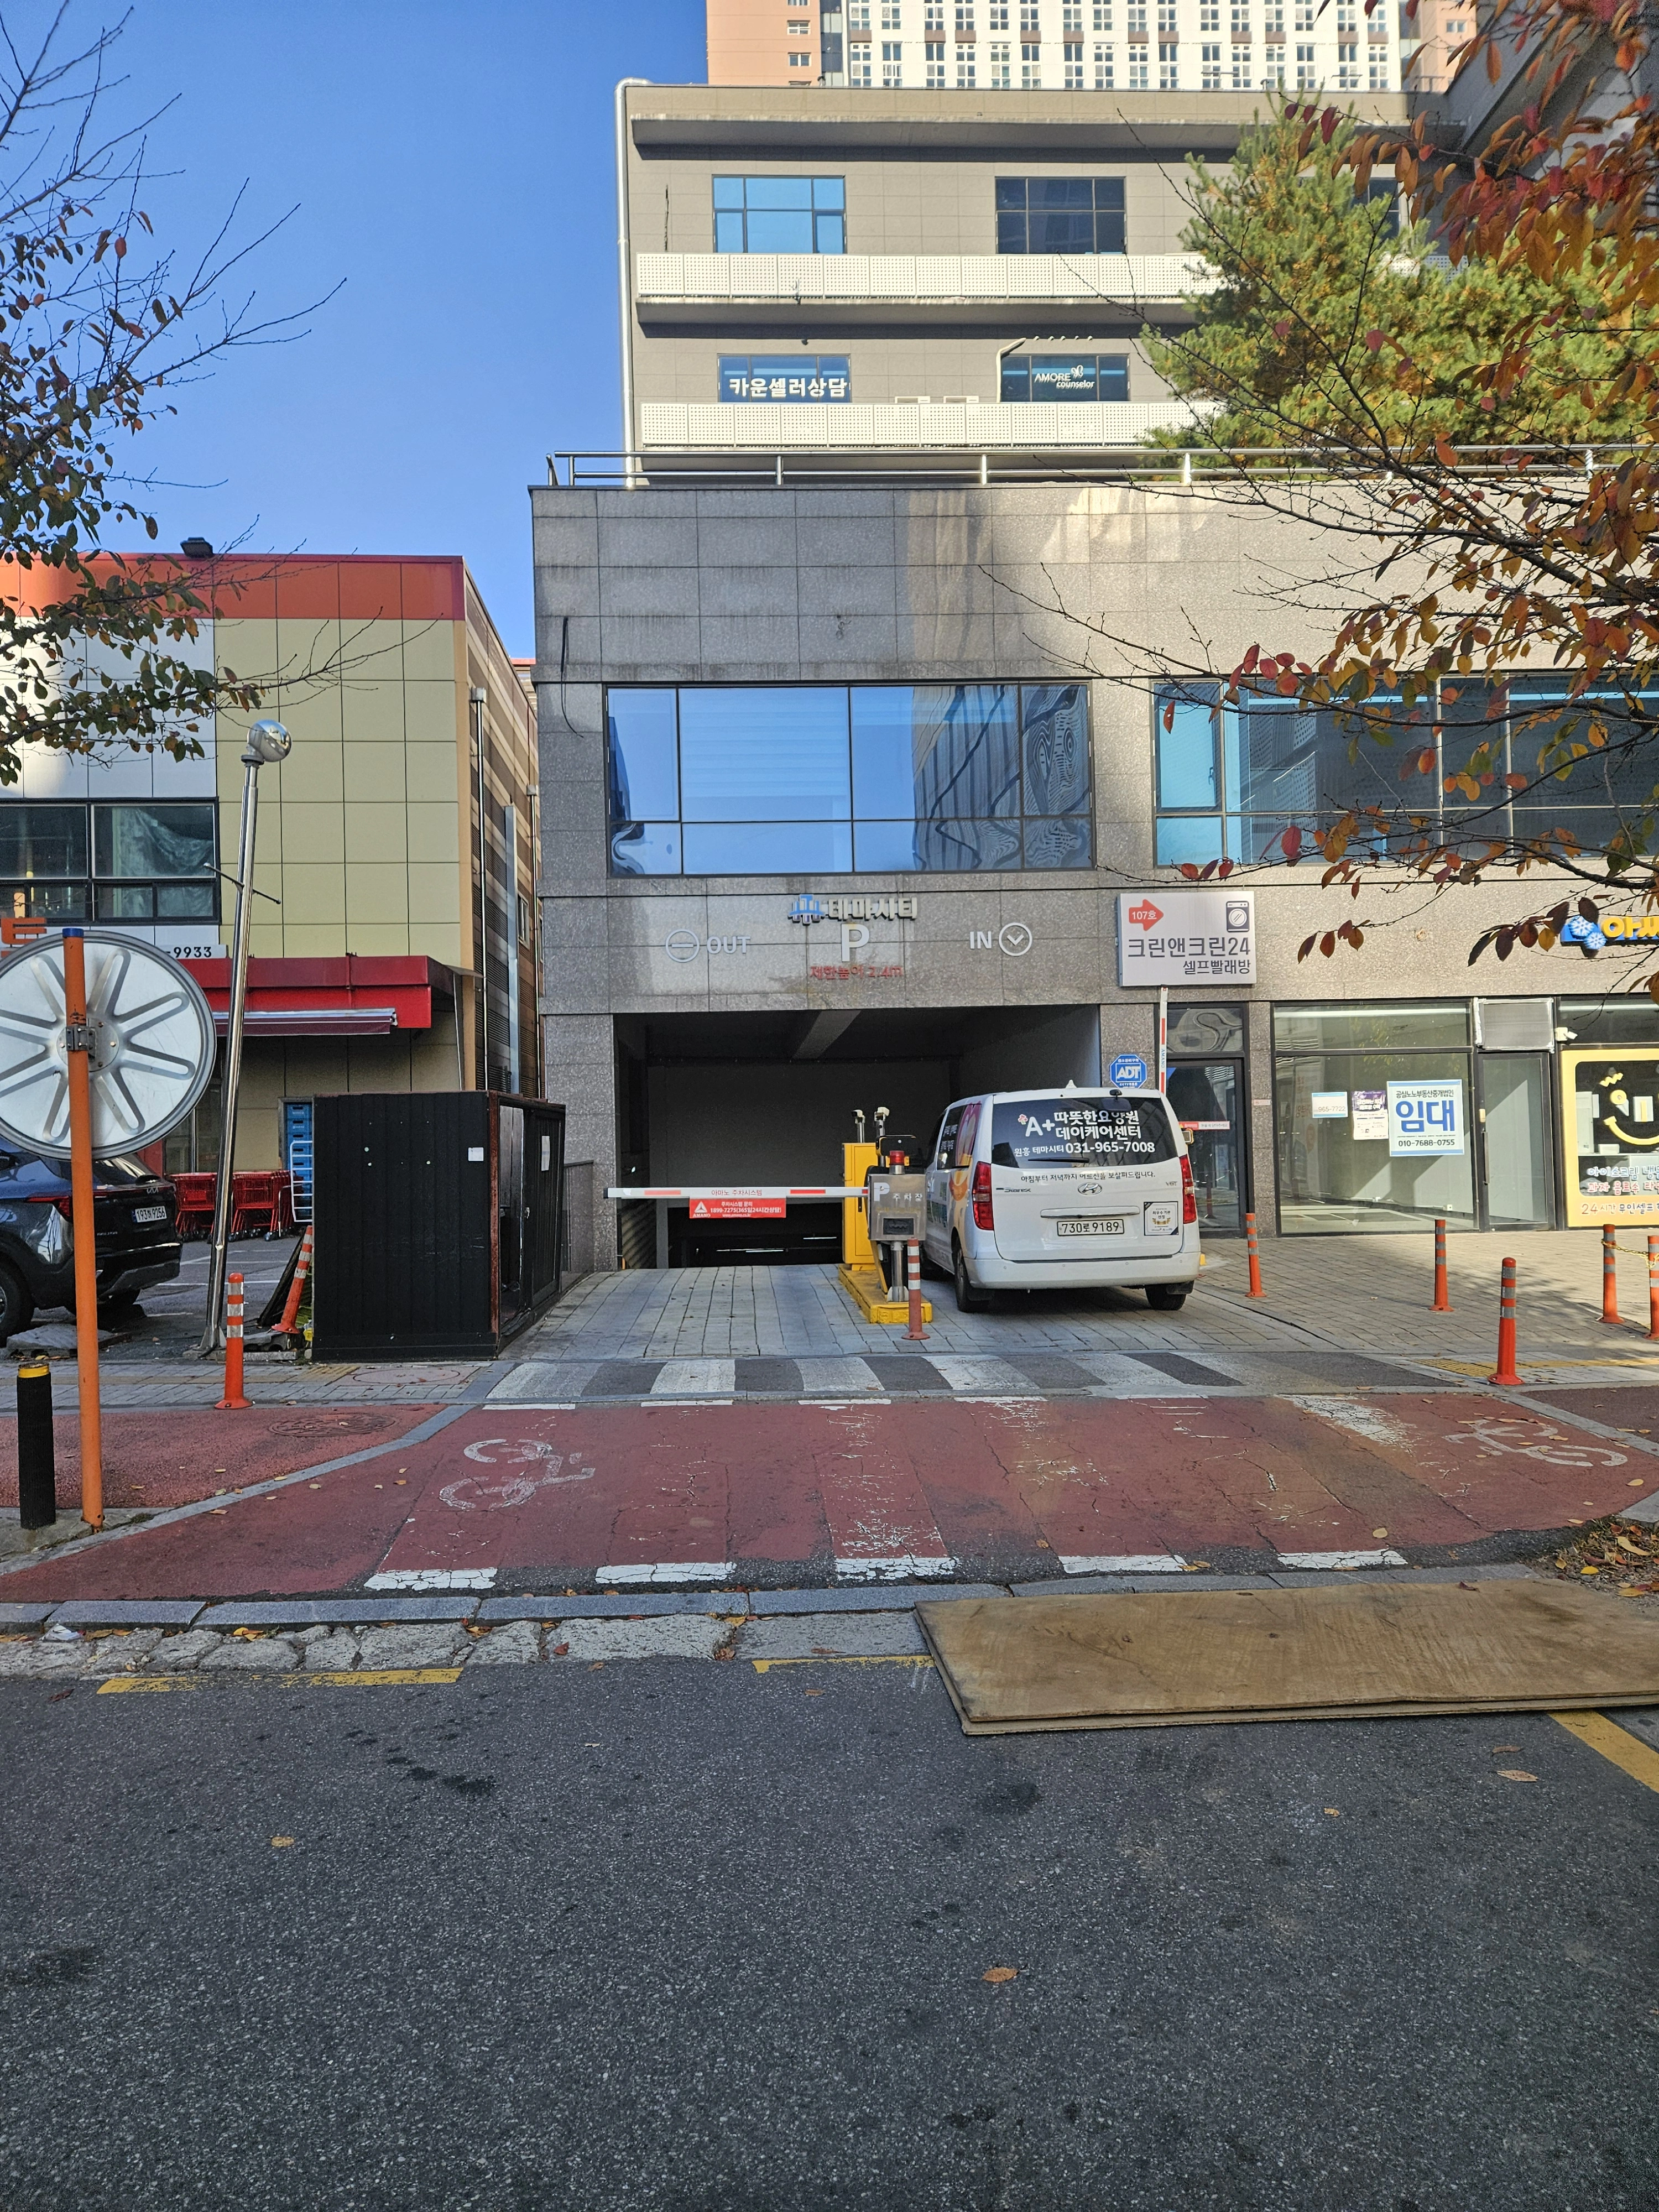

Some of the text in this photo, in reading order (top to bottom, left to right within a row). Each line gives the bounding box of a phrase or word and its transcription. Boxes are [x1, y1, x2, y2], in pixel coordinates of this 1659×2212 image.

[1034, 373, 1071, 383] AMORE
[1056, 380, 1095, 389] counselor
[729, 377, 847, 398] 카운셀러상담
[828, 897, 917, 920] 테마시티
[1132, 910, 1157, 920] 107호
[707, 936, 751, 954] OUT
[841, 924, 870, 962] P
[969, 931, 992, 950] IN
[1128, 937, 1251, 958] 크린앤크린24
[868, 965, 904, 978] 2.4m
[1183, 959, 1251, 975] 셀프빨래방
[1117, 1066, 1140, 1079] ADT
[1396, 1089, 1454, 1098] 공실노노부동산중개법인
[1395, 1100, 1455, 1133] 임대
[1025, 1116, 1055, 1137] A+
[1055, 1125, 1141, 1140] 데이케어센터
[1014, 1141, 1155, 1157] 원흥 테마시티 031-965-7008
[1021, 1174, 1048, 1183] 아침부터
[1050, 1173, 1078, 1182] 저녁까지
[1587, 1166, 1640, 1180] 아이스크림
[874, 1182, 923, 1202] P 주차장
[1587, 1182, 1610, 1192] 과자
[1582, 1203, 1616, 1214] 24시간
[1619, 1203, 1653, 1214] 무인셀프
